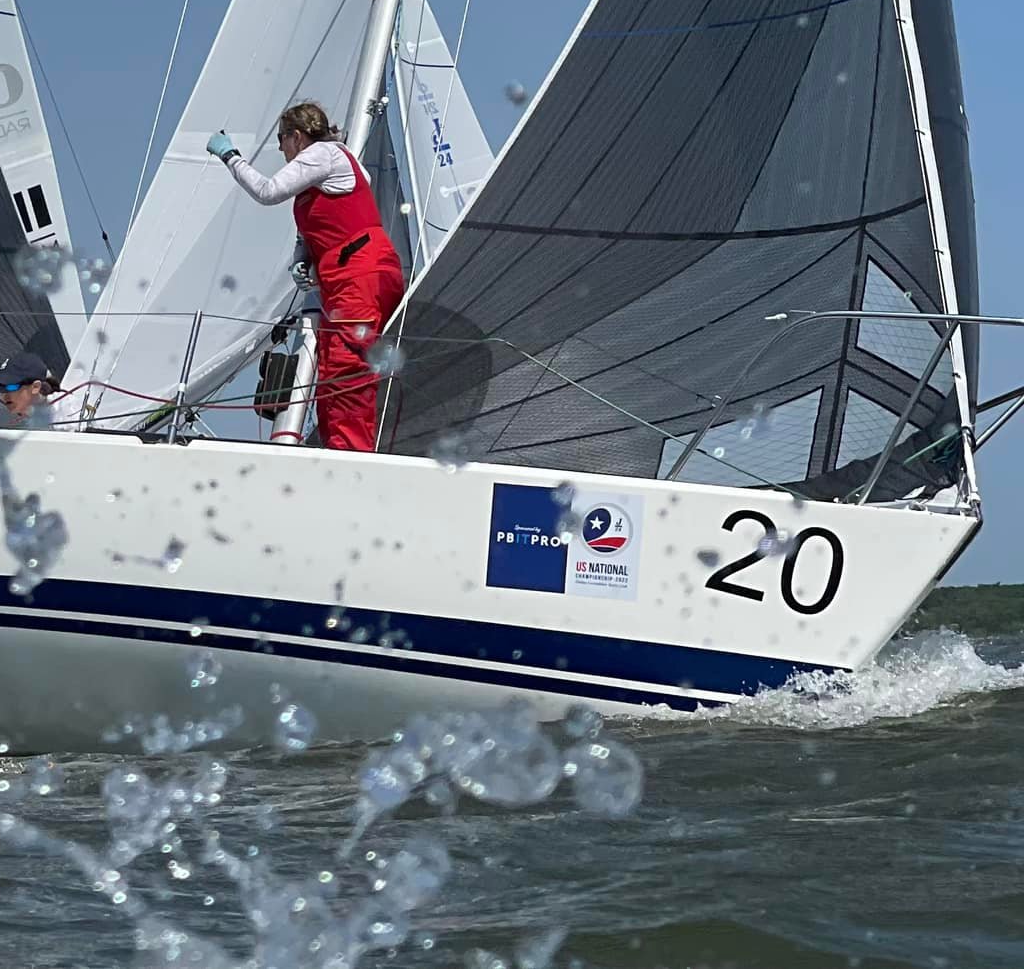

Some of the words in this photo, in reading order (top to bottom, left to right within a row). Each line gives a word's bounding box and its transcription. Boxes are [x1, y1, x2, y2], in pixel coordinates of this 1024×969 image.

[437, 152, 453, 167] 24
[496, 531, 561, 548] PBITPRO
[576, 560, 588, 572] US
[588, 562, 629, 577] NATIONAL
[705, 509, 845, 616] 20
